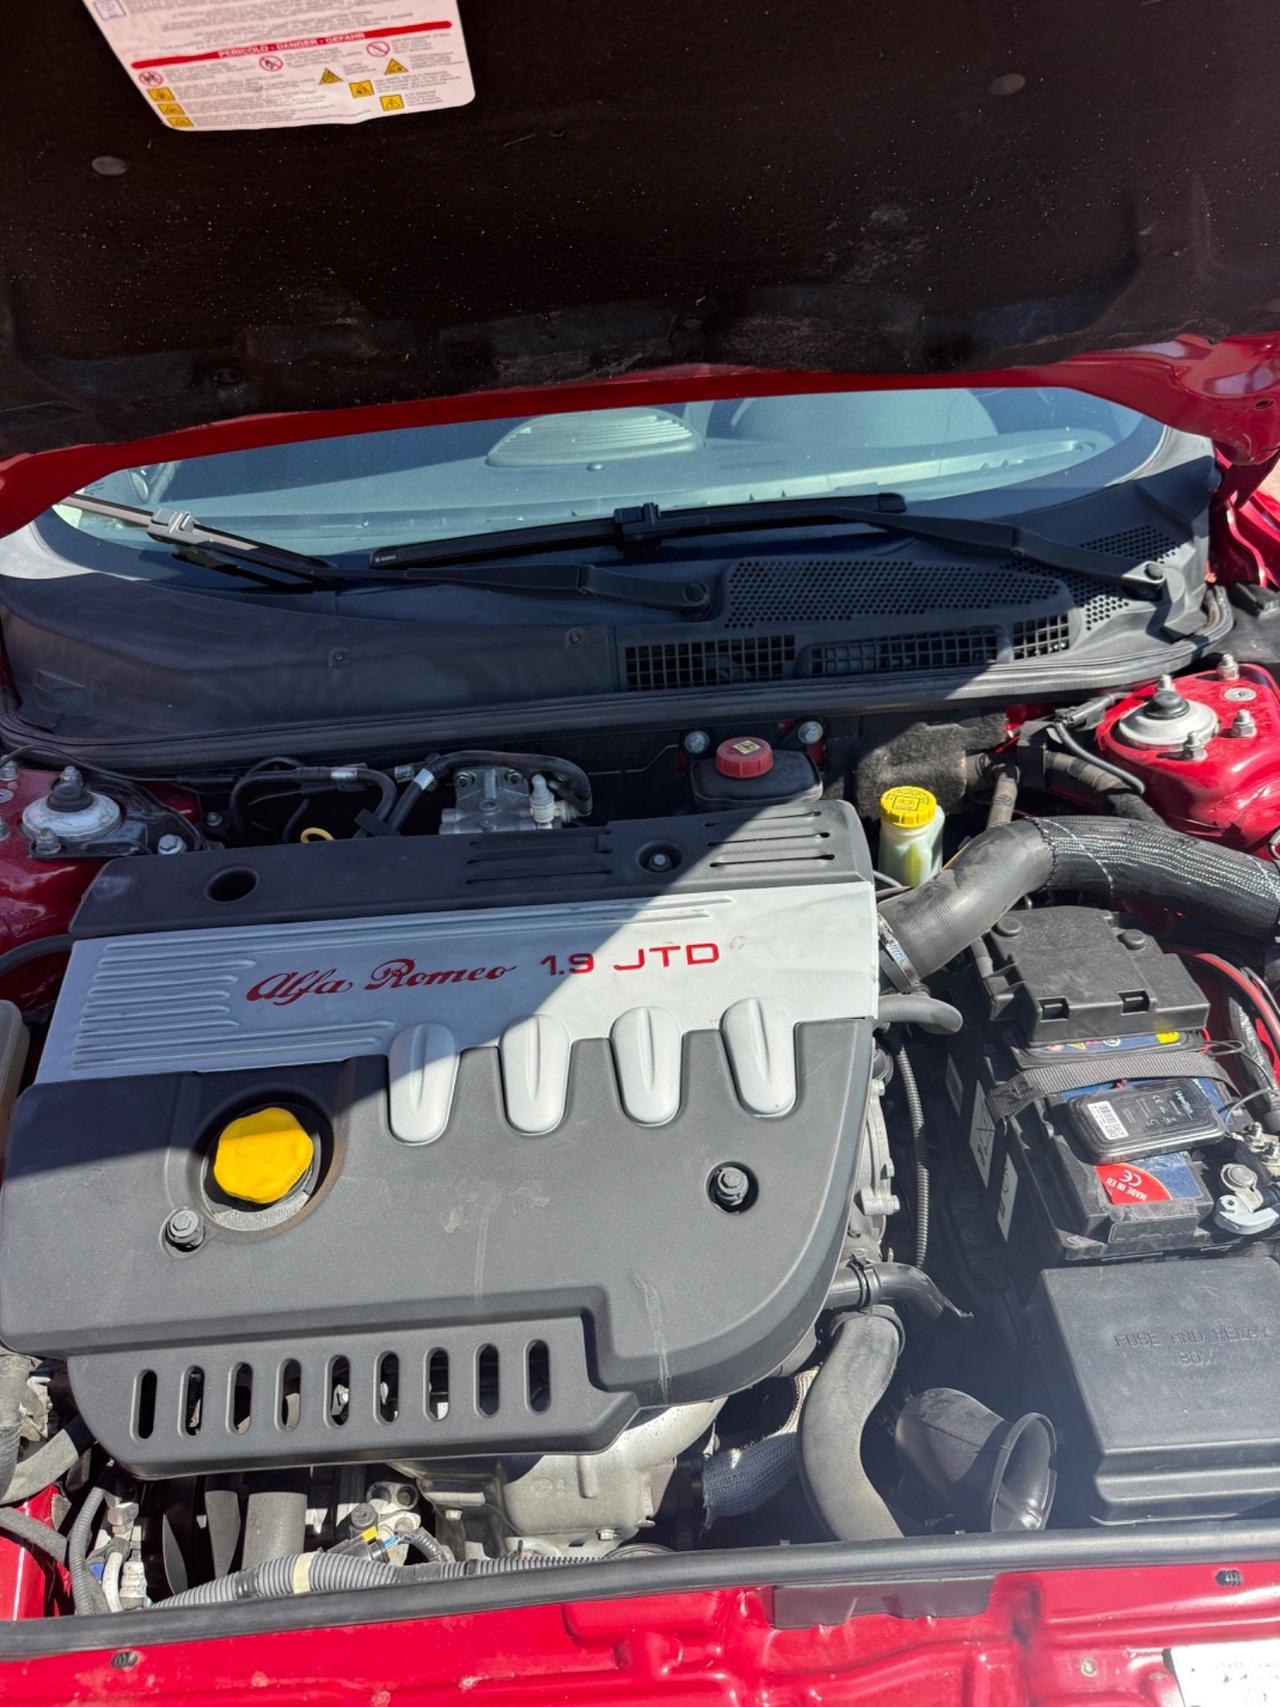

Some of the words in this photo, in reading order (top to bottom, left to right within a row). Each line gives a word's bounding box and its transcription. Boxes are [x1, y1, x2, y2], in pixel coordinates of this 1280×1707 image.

[219, 45, 269, 58] PERICOLO
[276, 39, 317, 51] DANGER
[325, 31, 365, 45] GEFAHR
[246, 968, 353, 1006] Alfa
[364, 958, 517, 992] Romeo
[540, 952, 596, 976] 1.9
[613, 943, 720, 971] JTD
[1116, 1182, 1128, 1192] IN
[1127, 1186, 1148, 1201] MADE
[1113, 1332, 1162, 1348] FUSE
[1170, 1329, 1206, 1345] AND
[1212, 1326, 1272, 1343] RELAY
[1177, 1351, 1217, 1366] BOX
